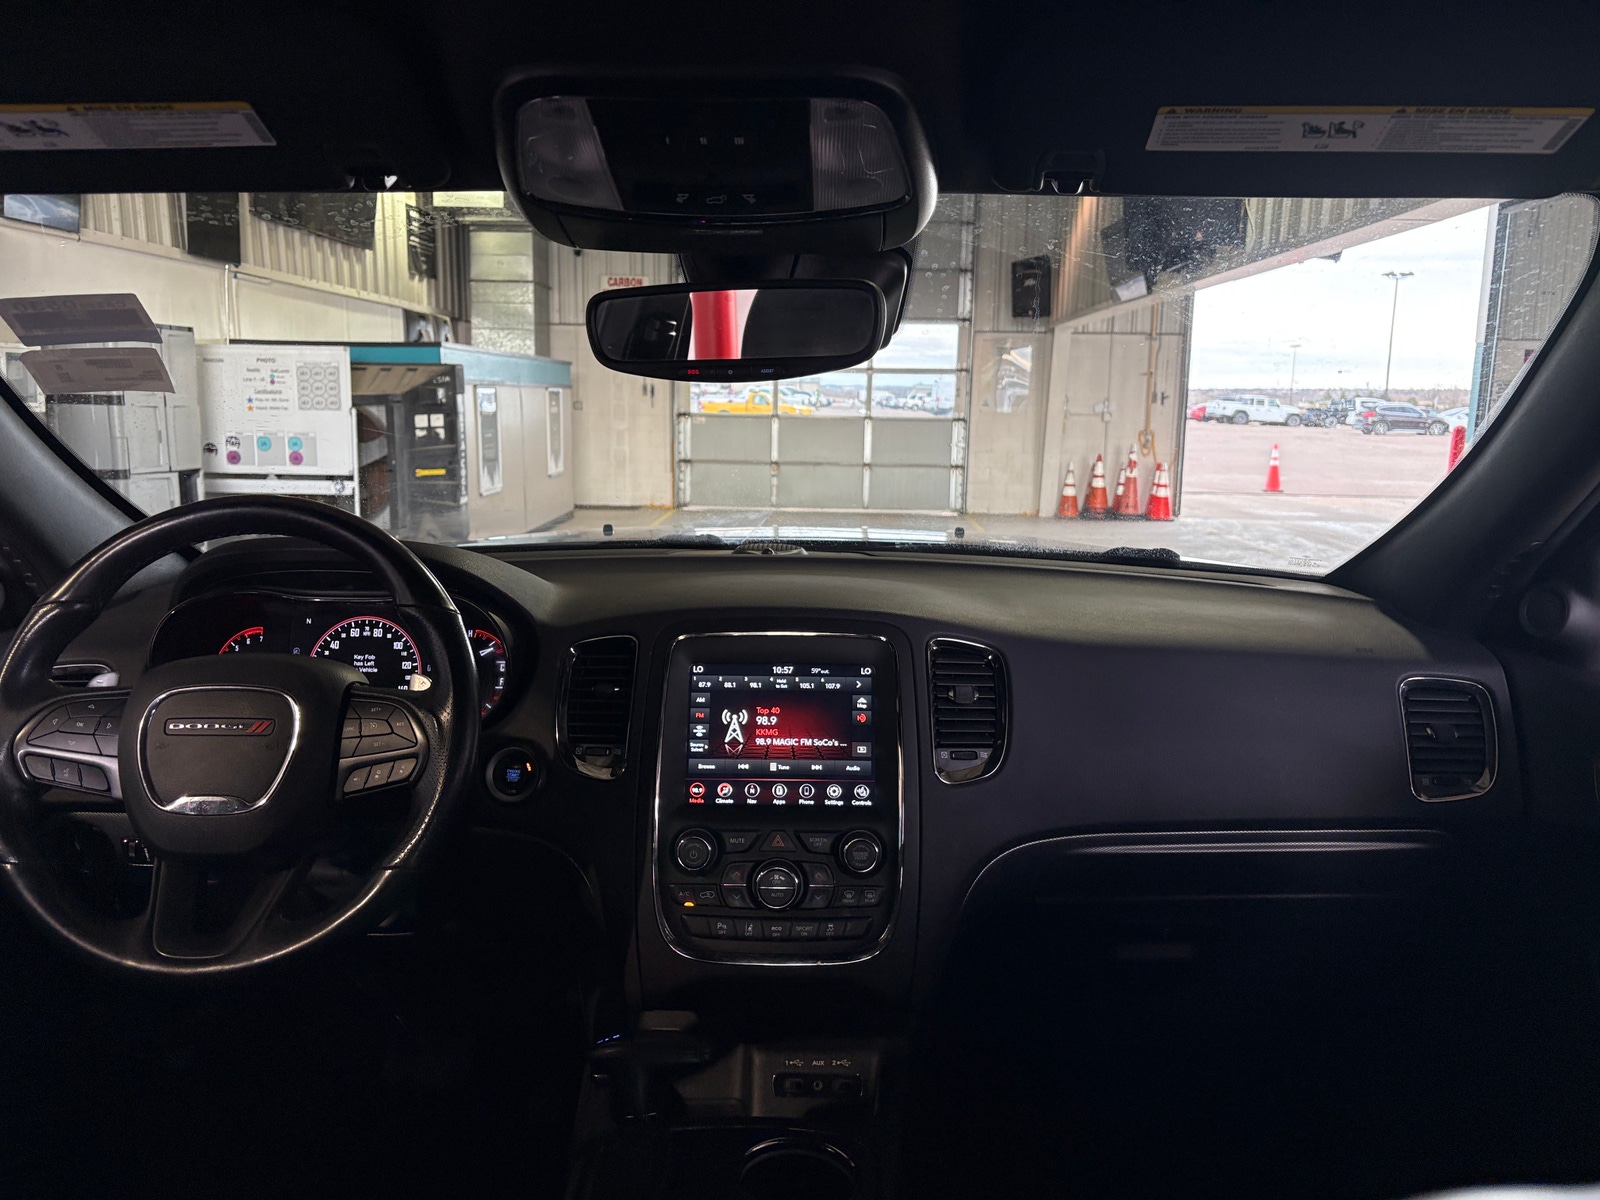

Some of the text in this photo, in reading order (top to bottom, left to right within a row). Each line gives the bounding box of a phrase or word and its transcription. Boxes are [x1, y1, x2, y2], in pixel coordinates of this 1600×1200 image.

[607, 276, 643, 288] CARBON
[350, 628, 360, 637] 60
[373, 628, 383, 637] 80
[468, 630, 474, 638] H
[259, 635, 264, 643] 7
[330, 640, 340, 650] 40
[393, 641, 403, 650] 100
[353, 654, 364, 662] Key
[402, 661, 412, 670] 120
[500, 663, 505, 672] C
[693, 665, 704, 673] LO
[772, 666, 793, 674] 10:57
[861, 667, 872, 675] LO
[698, 681, 711, 689] 87.9
[723, 681, 736, 689] 88.1
[756, 706, 770, 716] Top
[755, 716, 777, 725] 98.9
[169, 722, 246, 730] DODGE
[755, 738, 771, 746] 98.9
[772, 738, 799, 746] MAGIC
[813, 739, 839, 747] SoCo's
[772, 798, 786, 806] Apps
[824, 799, 844, 807] Settings
